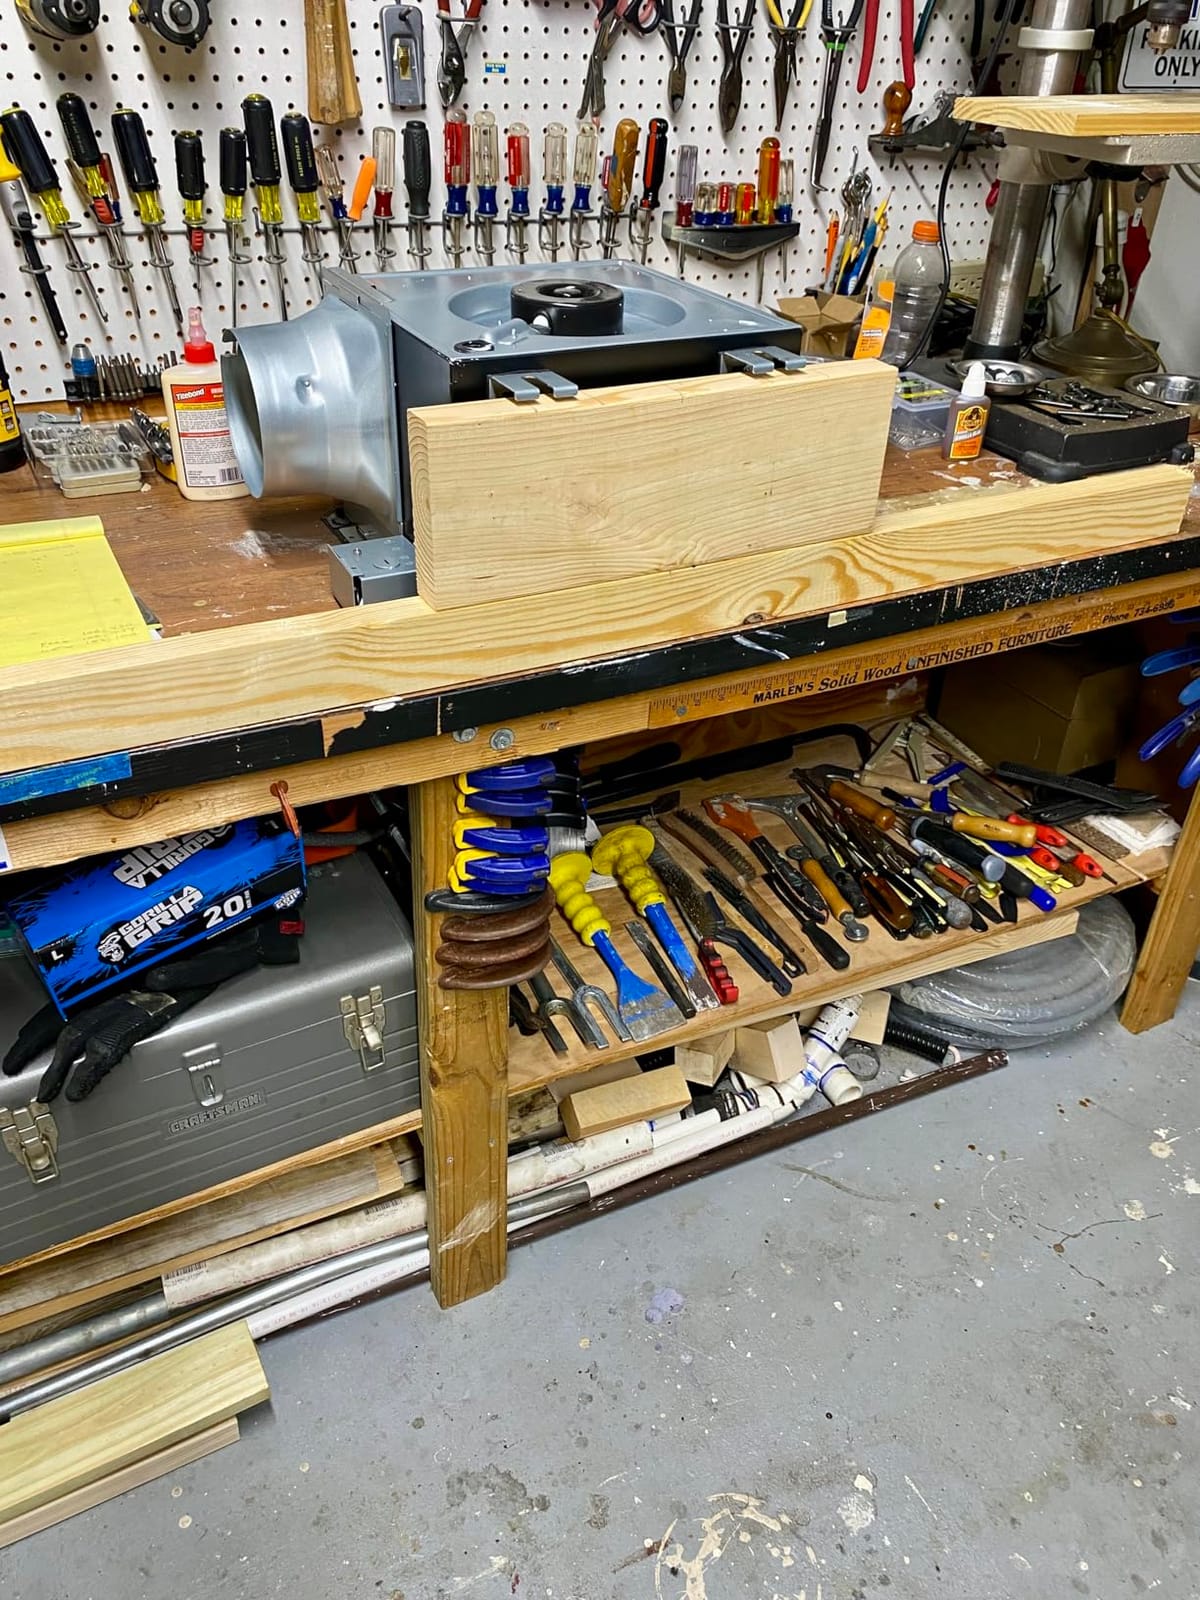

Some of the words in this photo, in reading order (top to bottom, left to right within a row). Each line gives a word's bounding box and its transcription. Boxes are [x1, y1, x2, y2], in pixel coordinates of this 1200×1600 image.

[1154, 55, 1200, 77] ONLY
[176, 388, 205, 400] Titebond
[1102, 612, 1129, 624] Phone
[753, 681, 814, 704] MARLEN'S
[818, 671, 858, 691] Solid
[863, 661, 902, 681] Wood
[905, 642, 994, 671] UNFINISHED
[997, 623, 1073, 651] FURNITURE
[125, 832, 215, 889] GORILLA
[118, 886, 198, 937] GORILLA
[123, 889, 204, 948] GRIP
[51, 950, 64, 960] L
[170, 1093, 260, 1133] CRAFTSMAN
